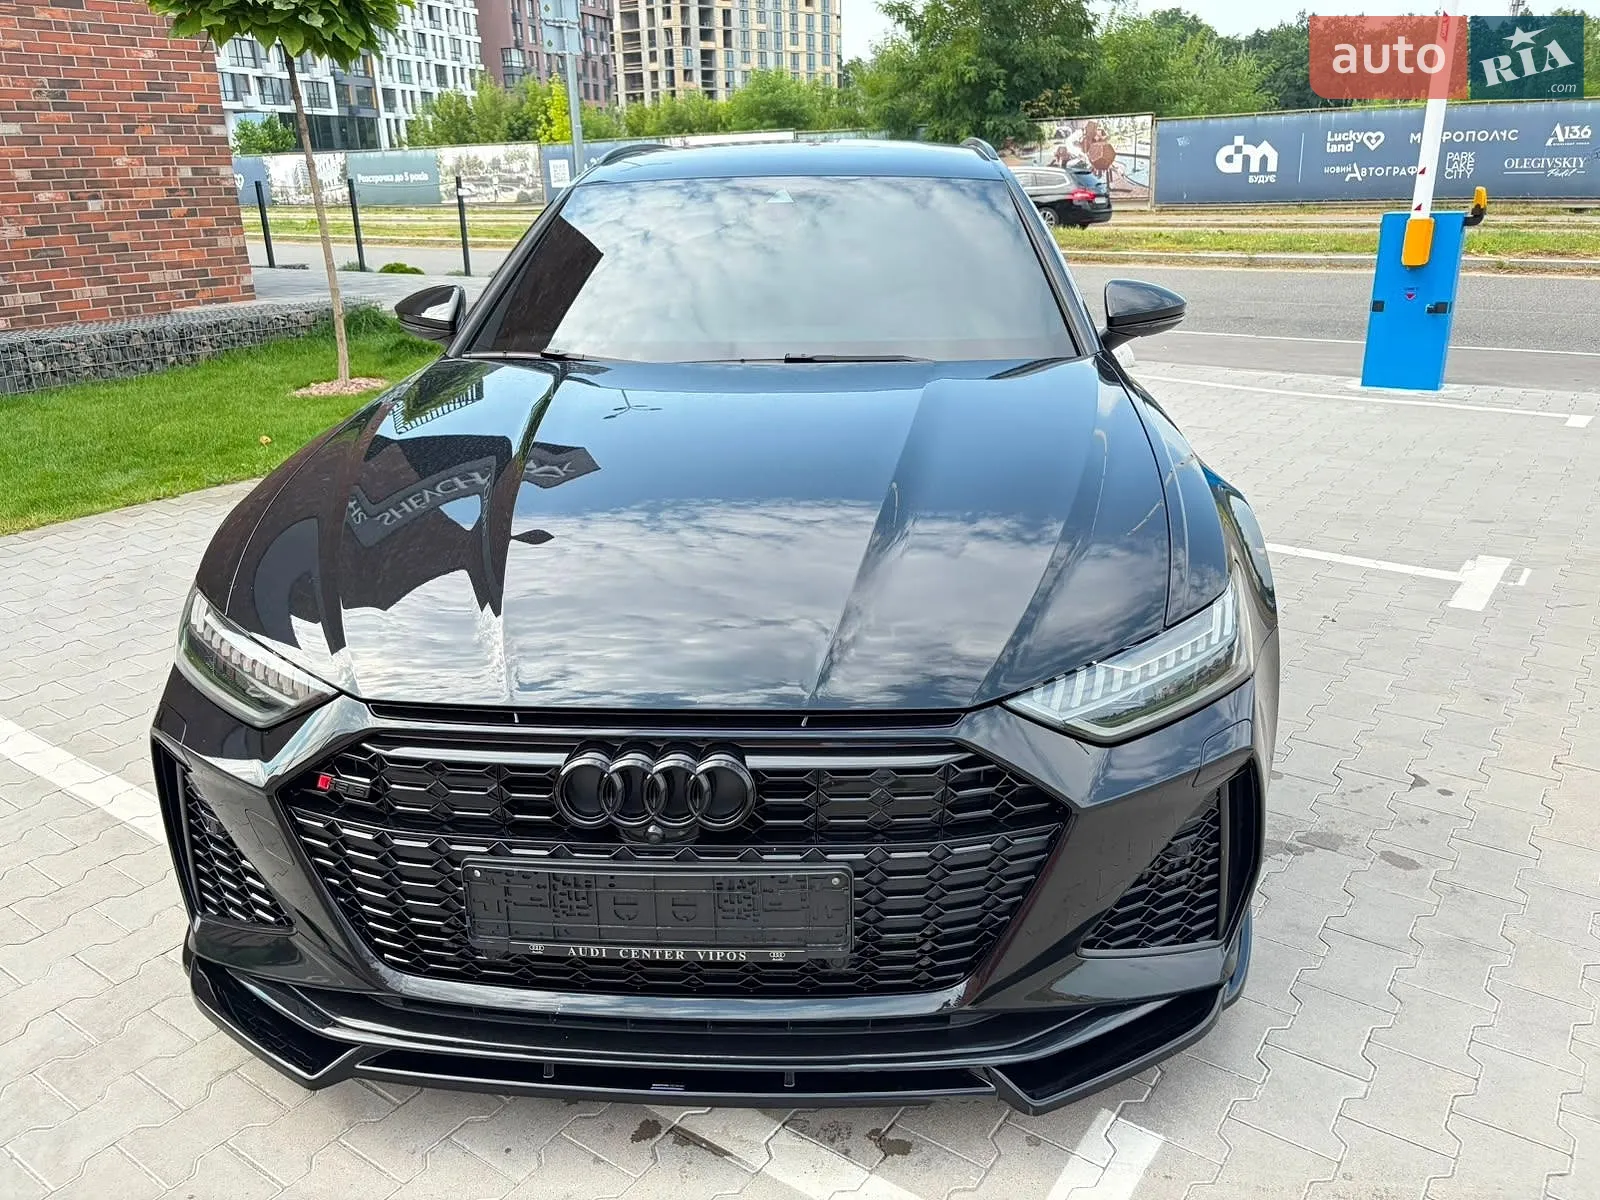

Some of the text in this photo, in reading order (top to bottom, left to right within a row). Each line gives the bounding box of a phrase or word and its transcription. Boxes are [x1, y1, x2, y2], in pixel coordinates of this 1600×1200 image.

[1327, 130, 1364, 143] Lucky
[1326, 142, 1354, 153] land
[1447, 151, 1476, 161] PARK
[1445, 160, 1475, 171] LAKE
[1504, 157, 1587, 169] OLEGIVSKIY
[1444, 169, 1474, 180] CITY
[567, 946, 747, 961] AUDI CENTER VIPOS
